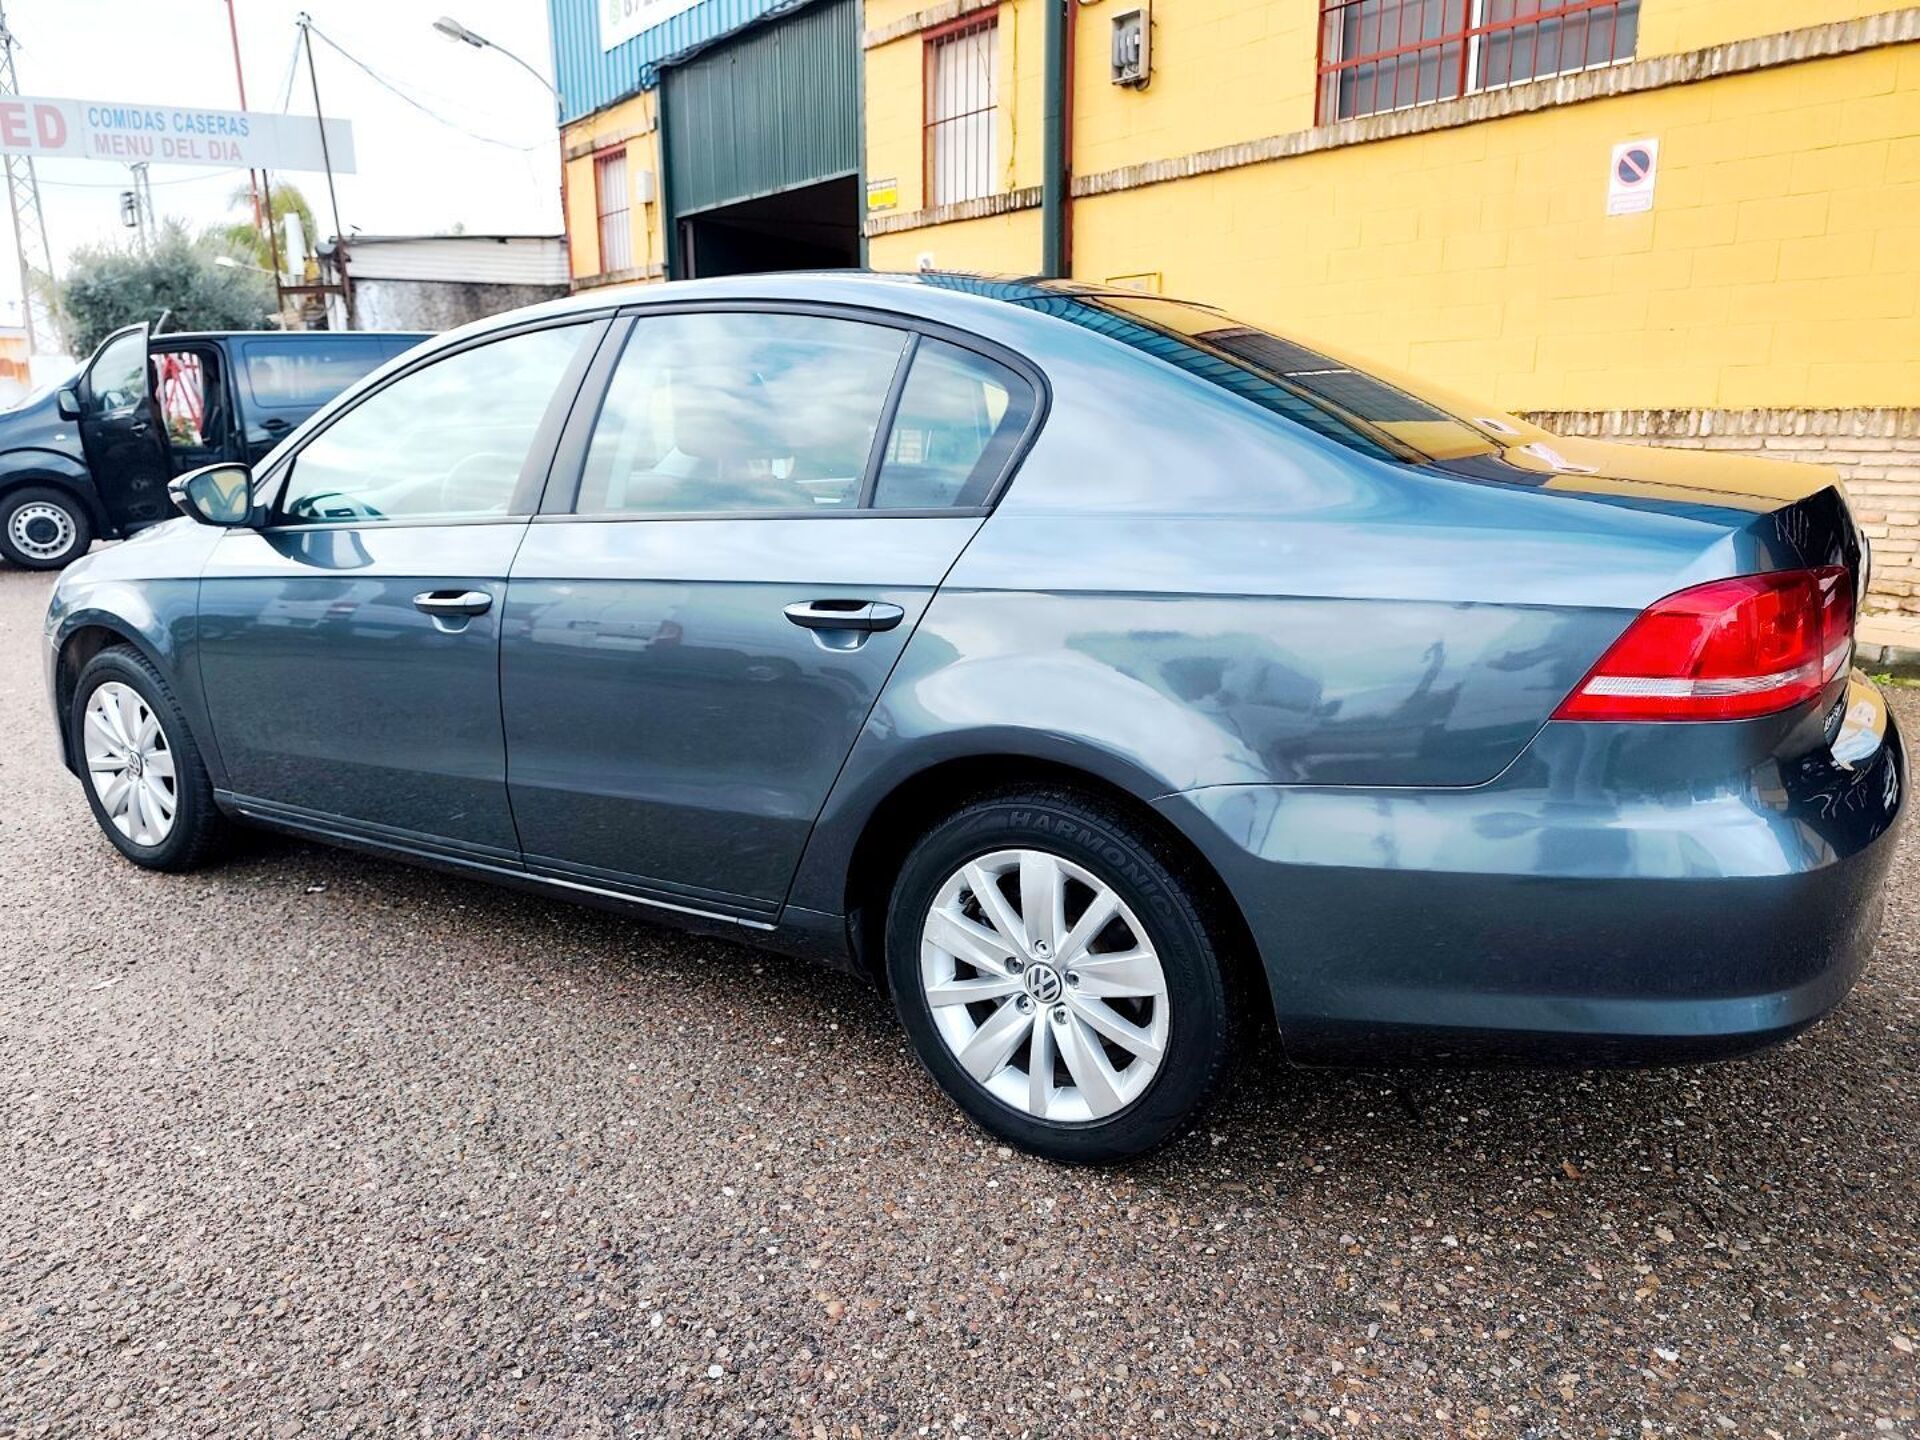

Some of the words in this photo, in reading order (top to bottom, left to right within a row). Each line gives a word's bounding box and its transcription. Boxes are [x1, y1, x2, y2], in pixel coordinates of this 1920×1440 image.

[88, 107, 165, 132] COMIDAS
[173, 112, 249, 137] CASERAS
[95, 134, 153, 156] MENU
[163, 138, 200, 159] DEL
[209, 140, 242, 161] DIA
[1009, 811, 1172, 916] HARMONIC
